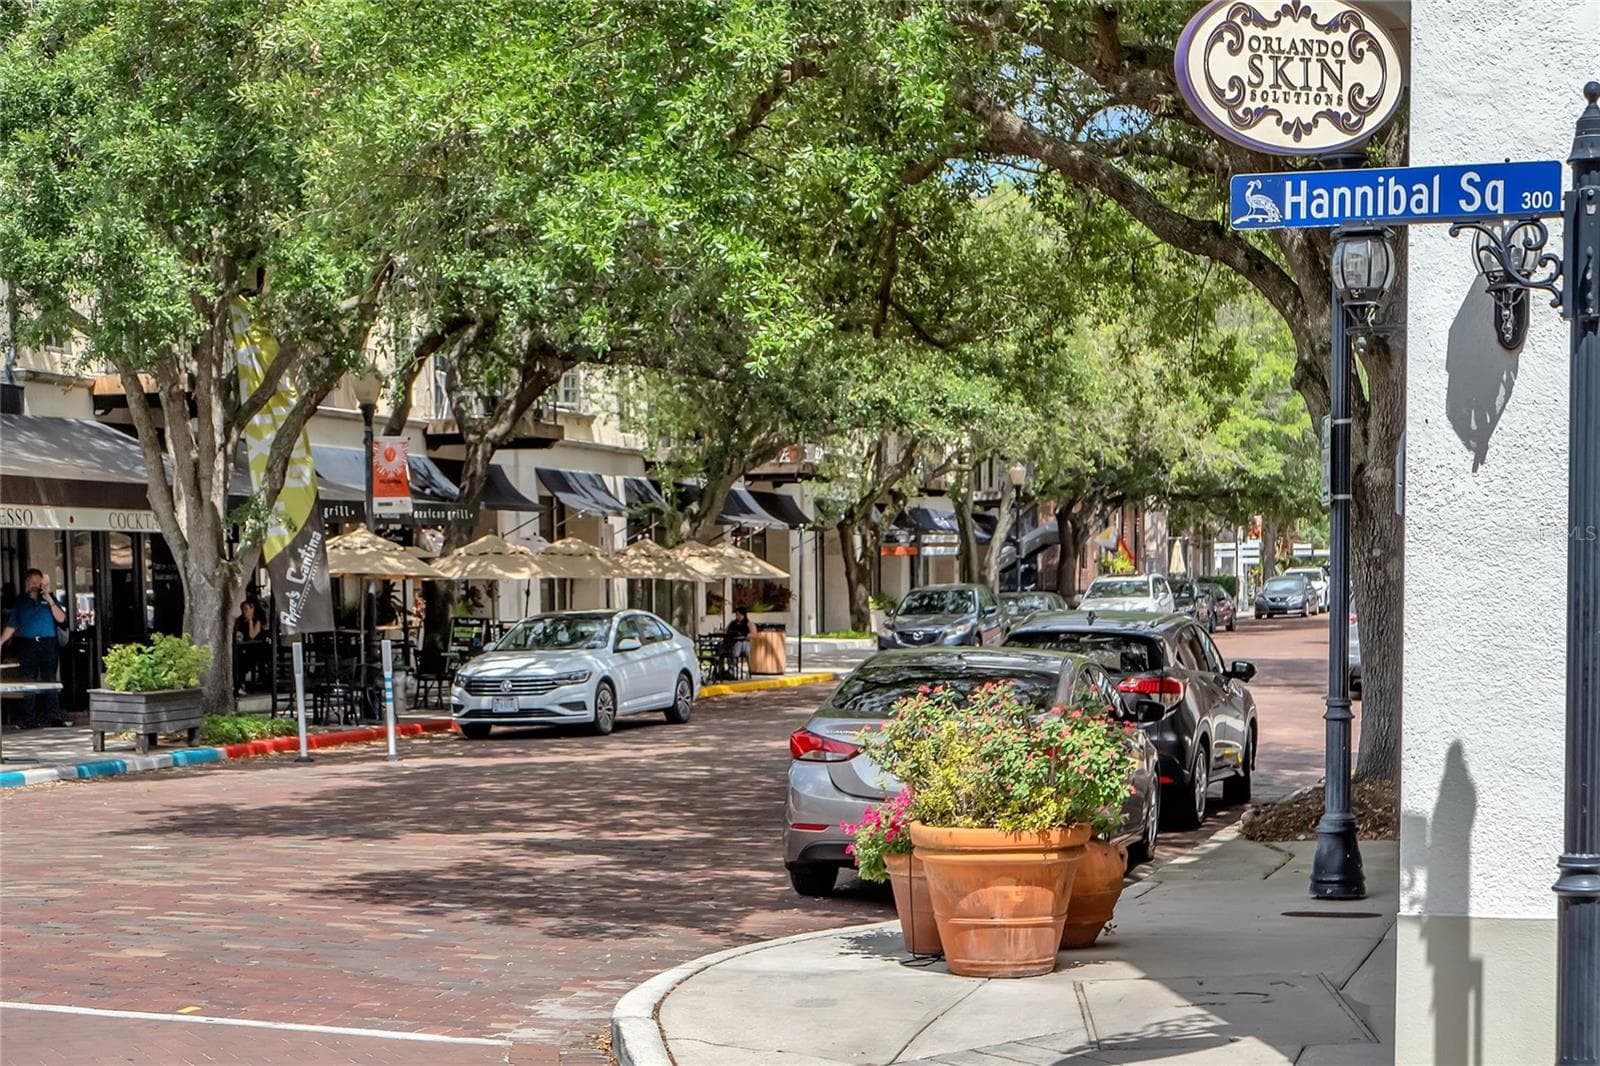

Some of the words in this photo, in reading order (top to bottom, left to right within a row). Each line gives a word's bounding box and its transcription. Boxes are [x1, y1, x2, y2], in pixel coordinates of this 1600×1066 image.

[1247, 35, 1344, 58] ORLANDO
[1247, 53, 1346, 93] SKIN
[1250, 89, 1343, 107] SOLUTIONS
[1284, 172, 1440, 220] Hannibal
[1459, 171, 1505, 214] Sq
[1521, 191, 1553, 209] 300
[286, 531, 322, 585] Cantina
[280, 590, 301, 628] Pepe's
